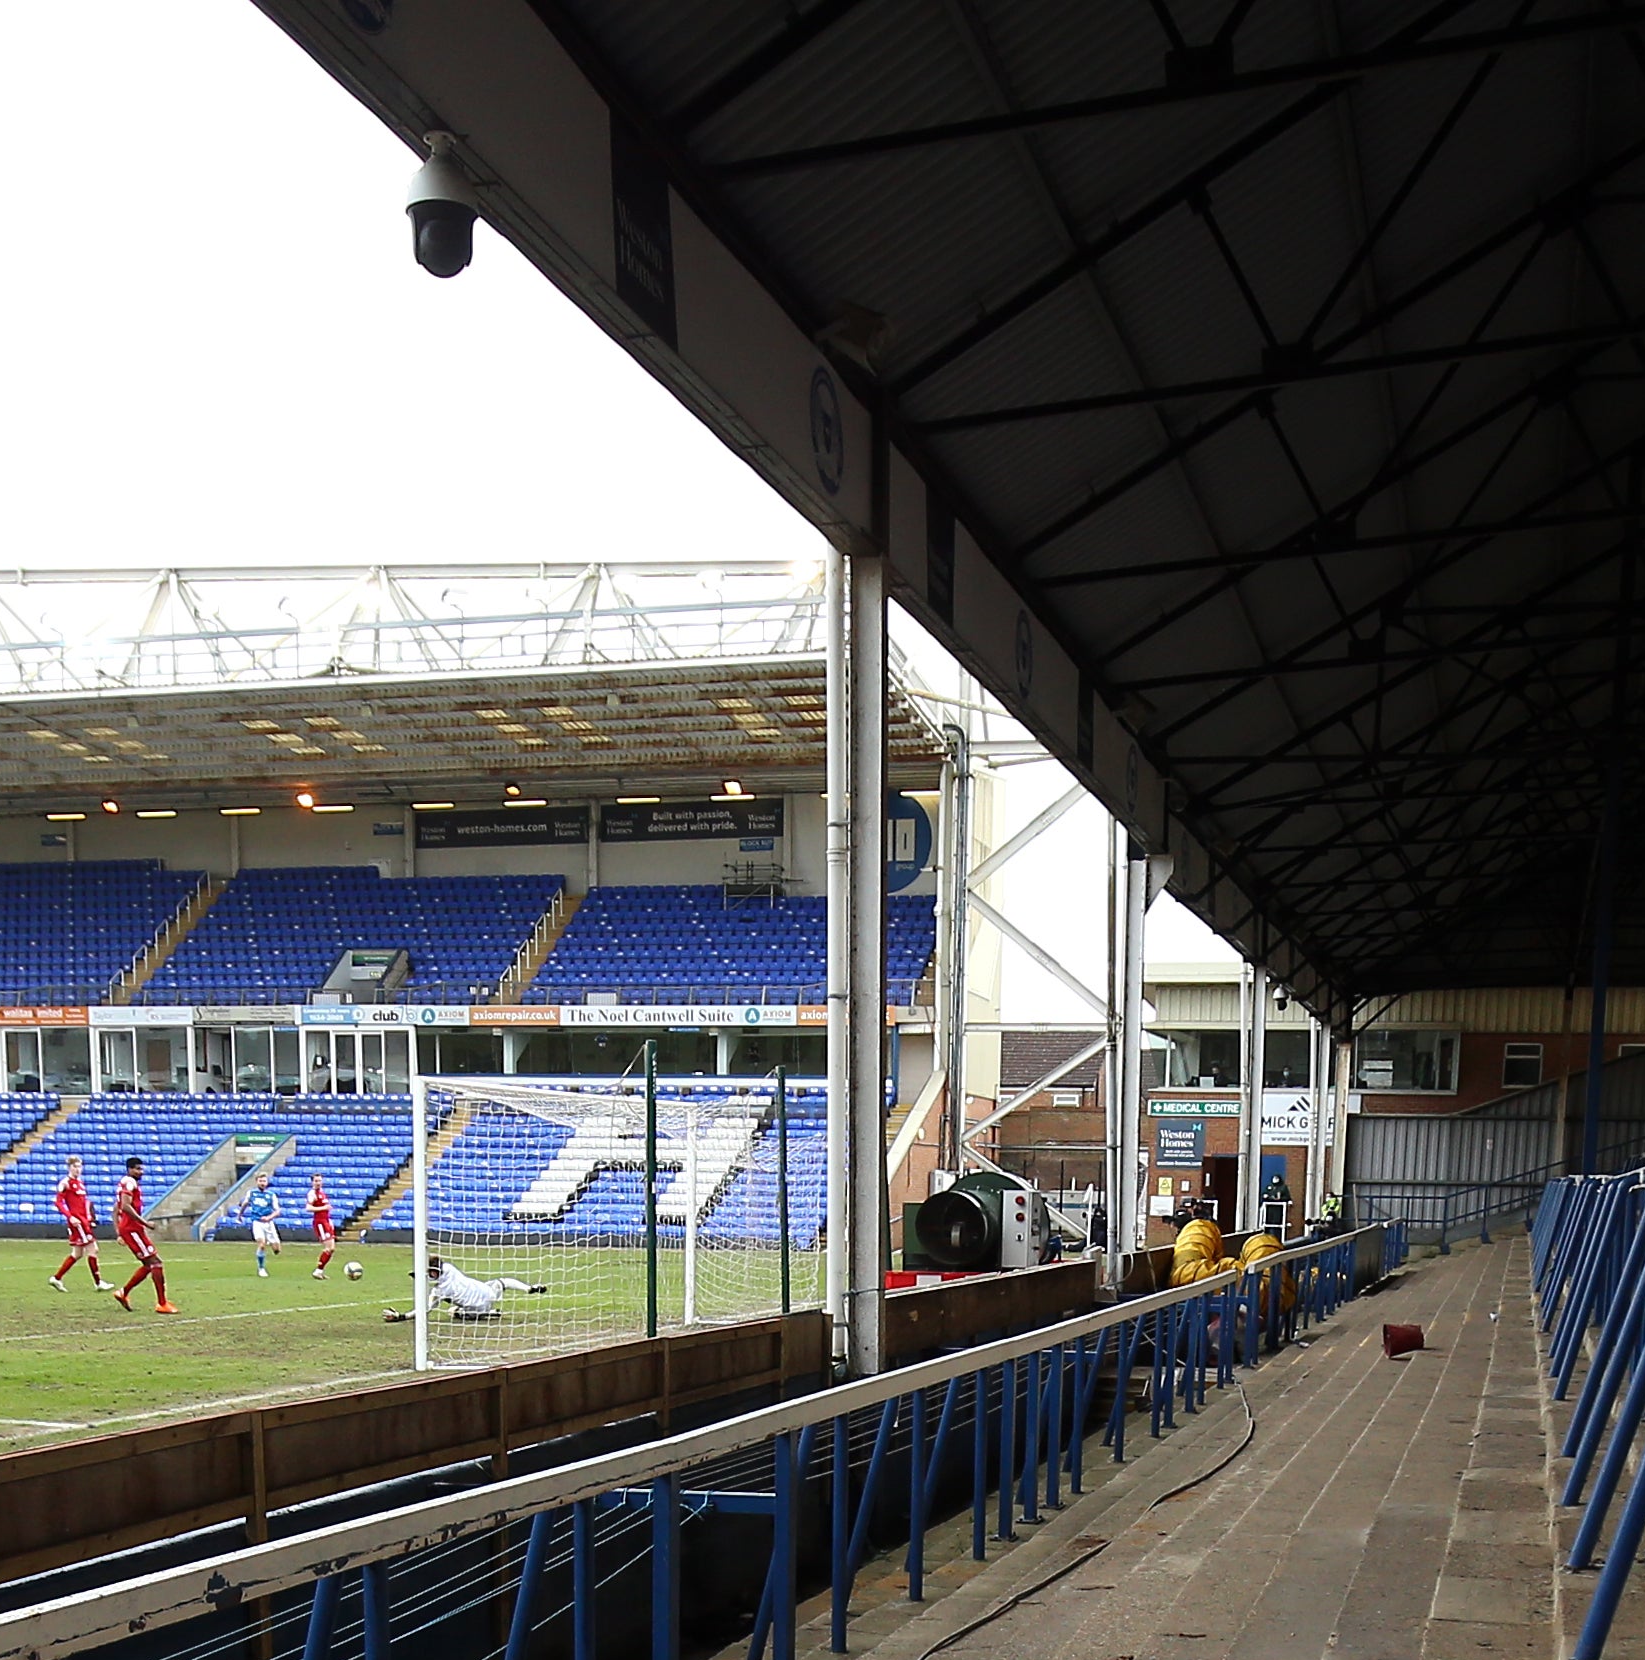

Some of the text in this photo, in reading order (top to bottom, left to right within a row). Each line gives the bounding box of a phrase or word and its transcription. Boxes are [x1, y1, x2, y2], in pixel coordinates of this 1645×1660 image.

[652, 809, 733, 821] Built with passion,
[747, 814, 776, 823] Weston
[457, 822, 547, 835] weston-homes.com
[647, 820, 737, 832] delivered with pride.
[748, 822, 776, 830] Homes
[372, 1009, 399, 1021] club
[438, 1010, 465, 1019] AXIOM
[473, 1009, 558, 1022] axiomrepair.co.uk
[568, 1008, 734, 1022] The Noel Cantwell Suite
[762, 1010, 792, 1018] AXIOM
[1163, 1101, 1239, 1113] MEDICAL CENTRE
[1261, 1116, 1296, 1129] MICK
[1160, 1129, 1195, 1139] Weston
[1160, 1138, 1194, 1148] Homes
